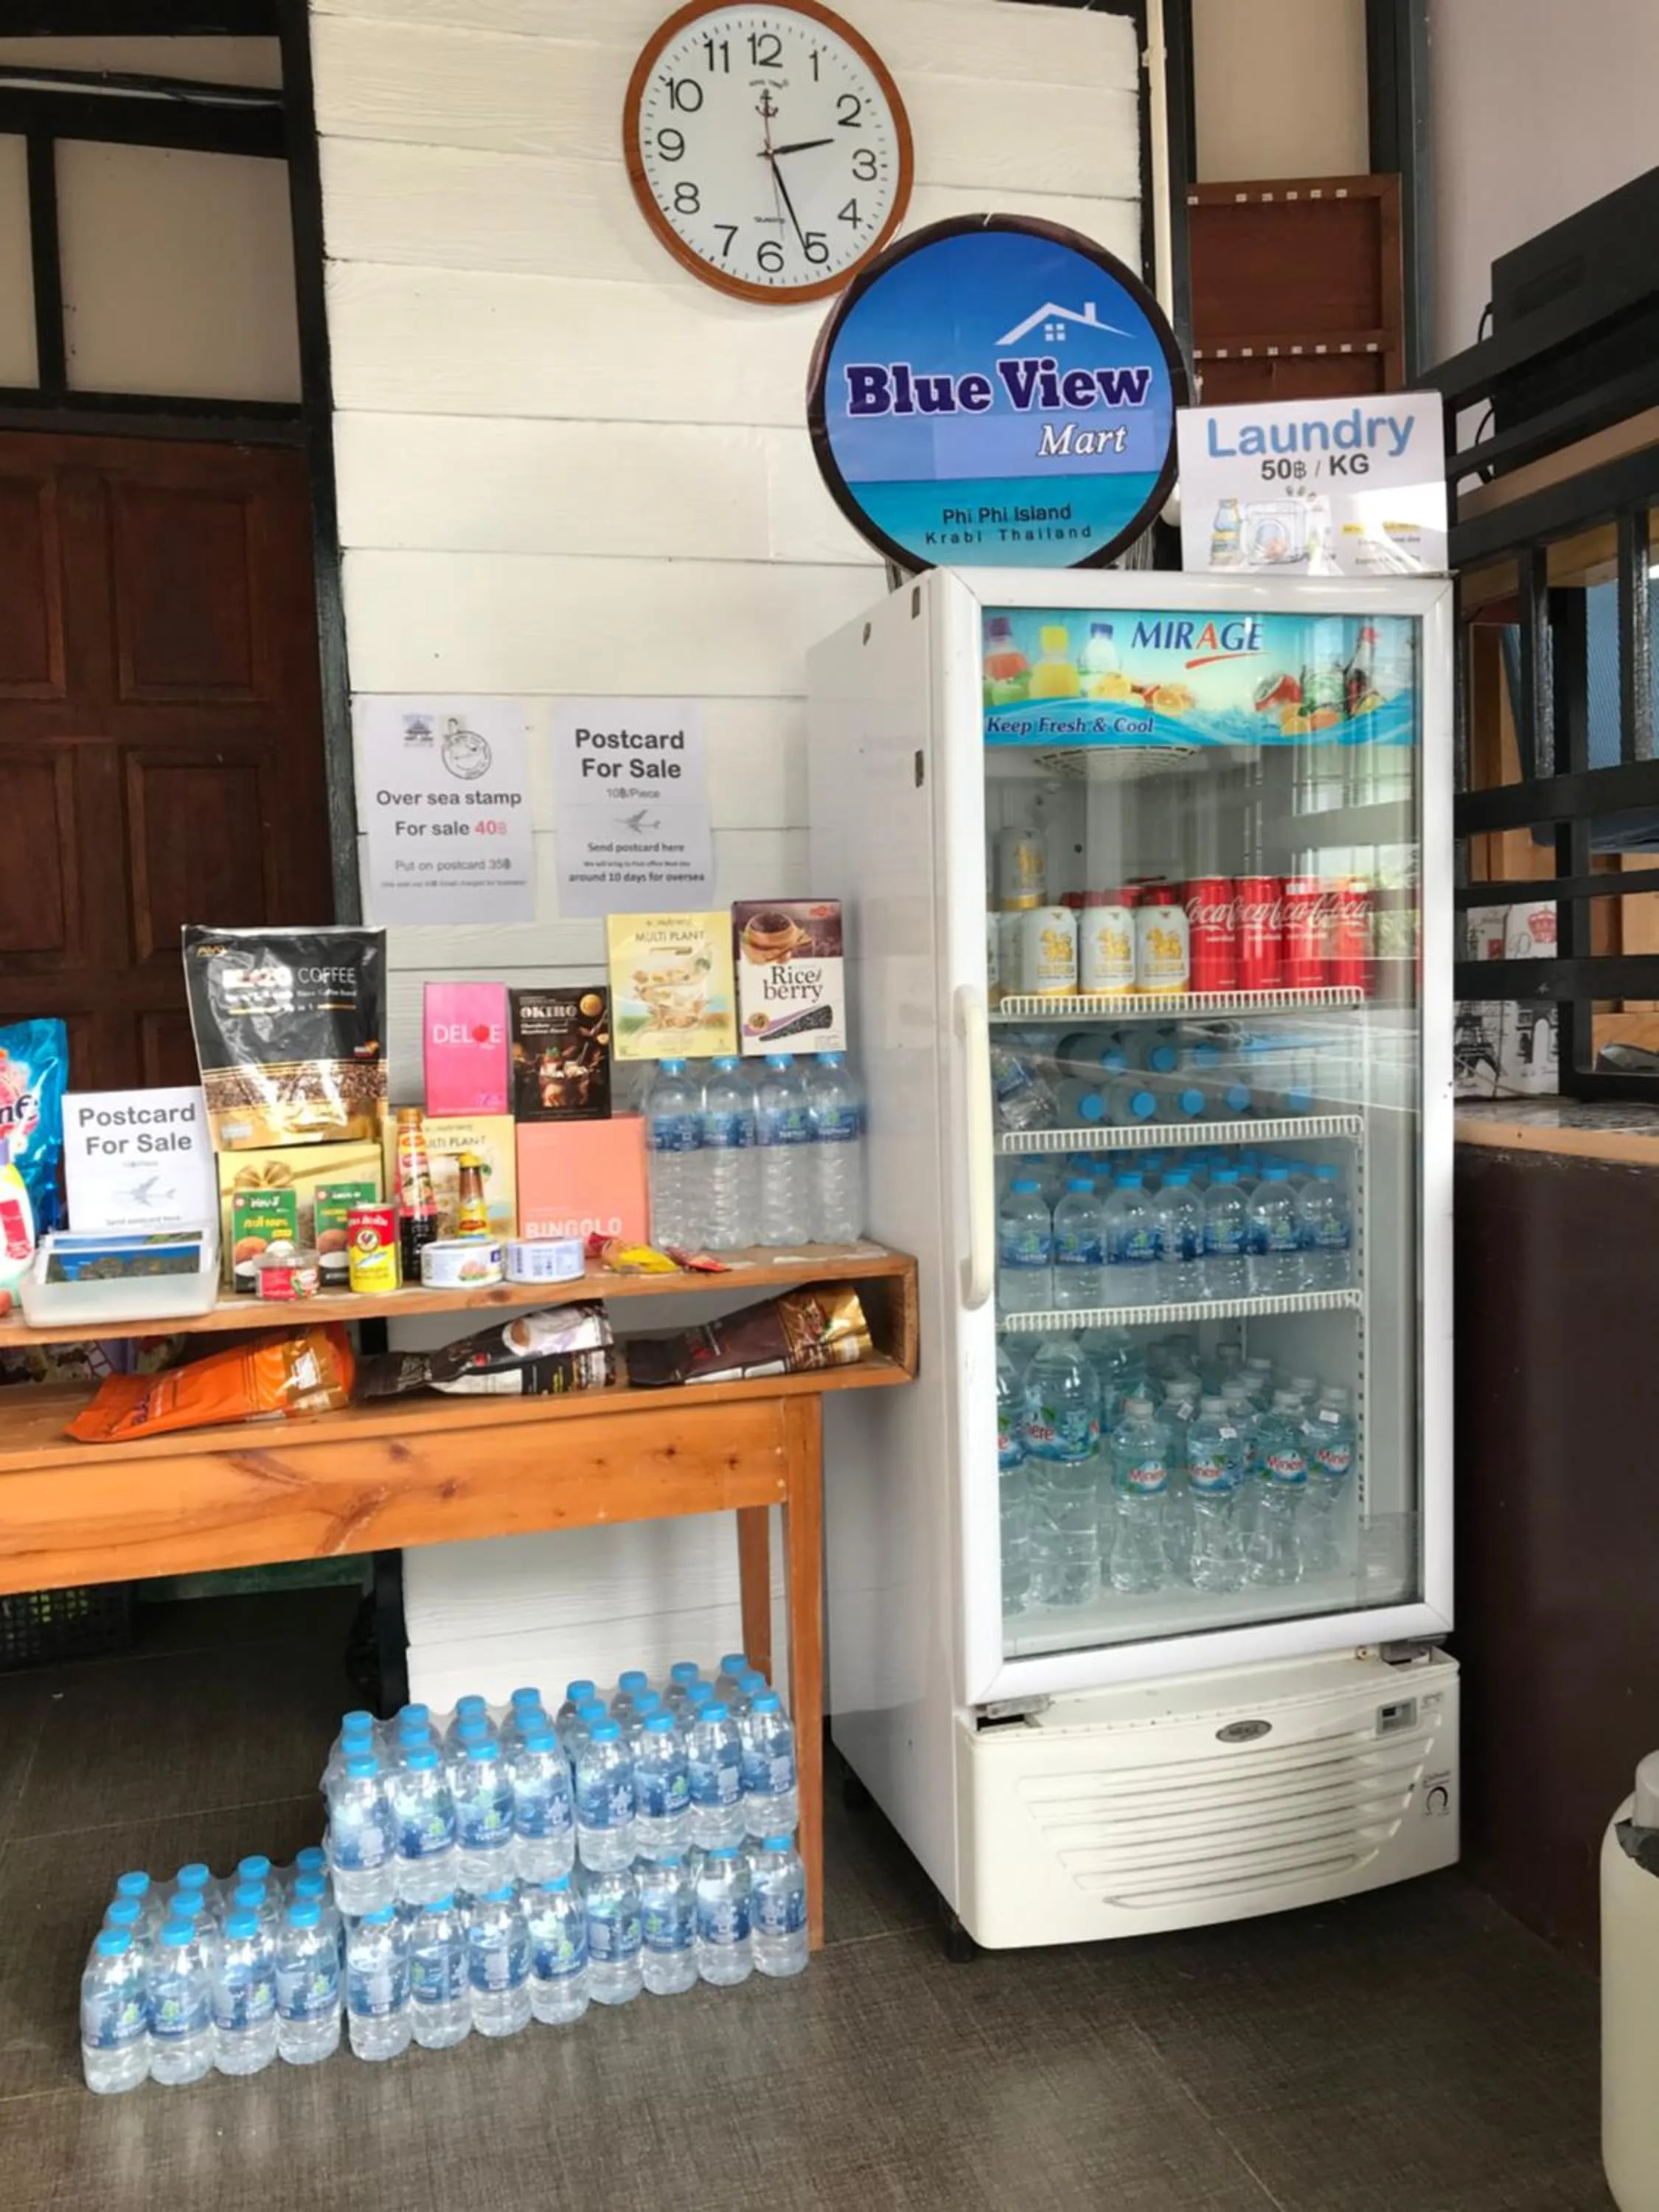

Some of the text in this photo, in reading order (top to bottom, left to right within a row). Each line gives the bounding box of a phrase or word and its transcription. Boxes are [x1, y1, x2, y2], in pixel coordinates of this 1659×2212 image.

[703, 38, 729, 73] 11
[748, 32, 783, 68] 12
[809, 49, 819, 82] 1
[665, 77, 703, 112] 10
[836, 94, 862, 128] 2
[657, 128, 685, 161] 9
[852, 149, 877, 181] 3
[674, 181, 700, 215] 8
[837, 198, 863, 229] 4
[713, 224, 738, 257] 7
[805, 232, 830, 264] 5
[757, 240, 785, 274] 6
[845, 357, 1151, 417] Blue View
[1037, 423, 1127, 457] Mart
[1207, 408, 1415, 458] Laundry
[1329, 453, 1370, 476] KG
[942, 504, 1072, 524] Phi Phi Island
[925, 526, 1091, 545] Krabi Thailand
[1131, 621, 1264, 650] MIRAGE
[575, 728, 685, 750] Postcard
[987, 714, 1154, 735] Keep Fresh & Cool
[582, 758, 681, 778] For Sale
[377, 790, 522, 808] Over sea stamp
[395, 821, 426, 836] For
[431, 821, 470, 836] sale
[588, 842, 685, 853] Send postcard here
[395, 860, 415, 871] Put
[419, 862, 434, 871] on
[437, 860, 485, 872] postcard
[568, 872, 706, 883] around 10 days for oversea
[297, 967, 357, 985] COFFEE
[763, 979, 823, 1003] berry
[79, 1103, 196, 1127] Postcard
[86, 1132, 192, 1156] For Sale
